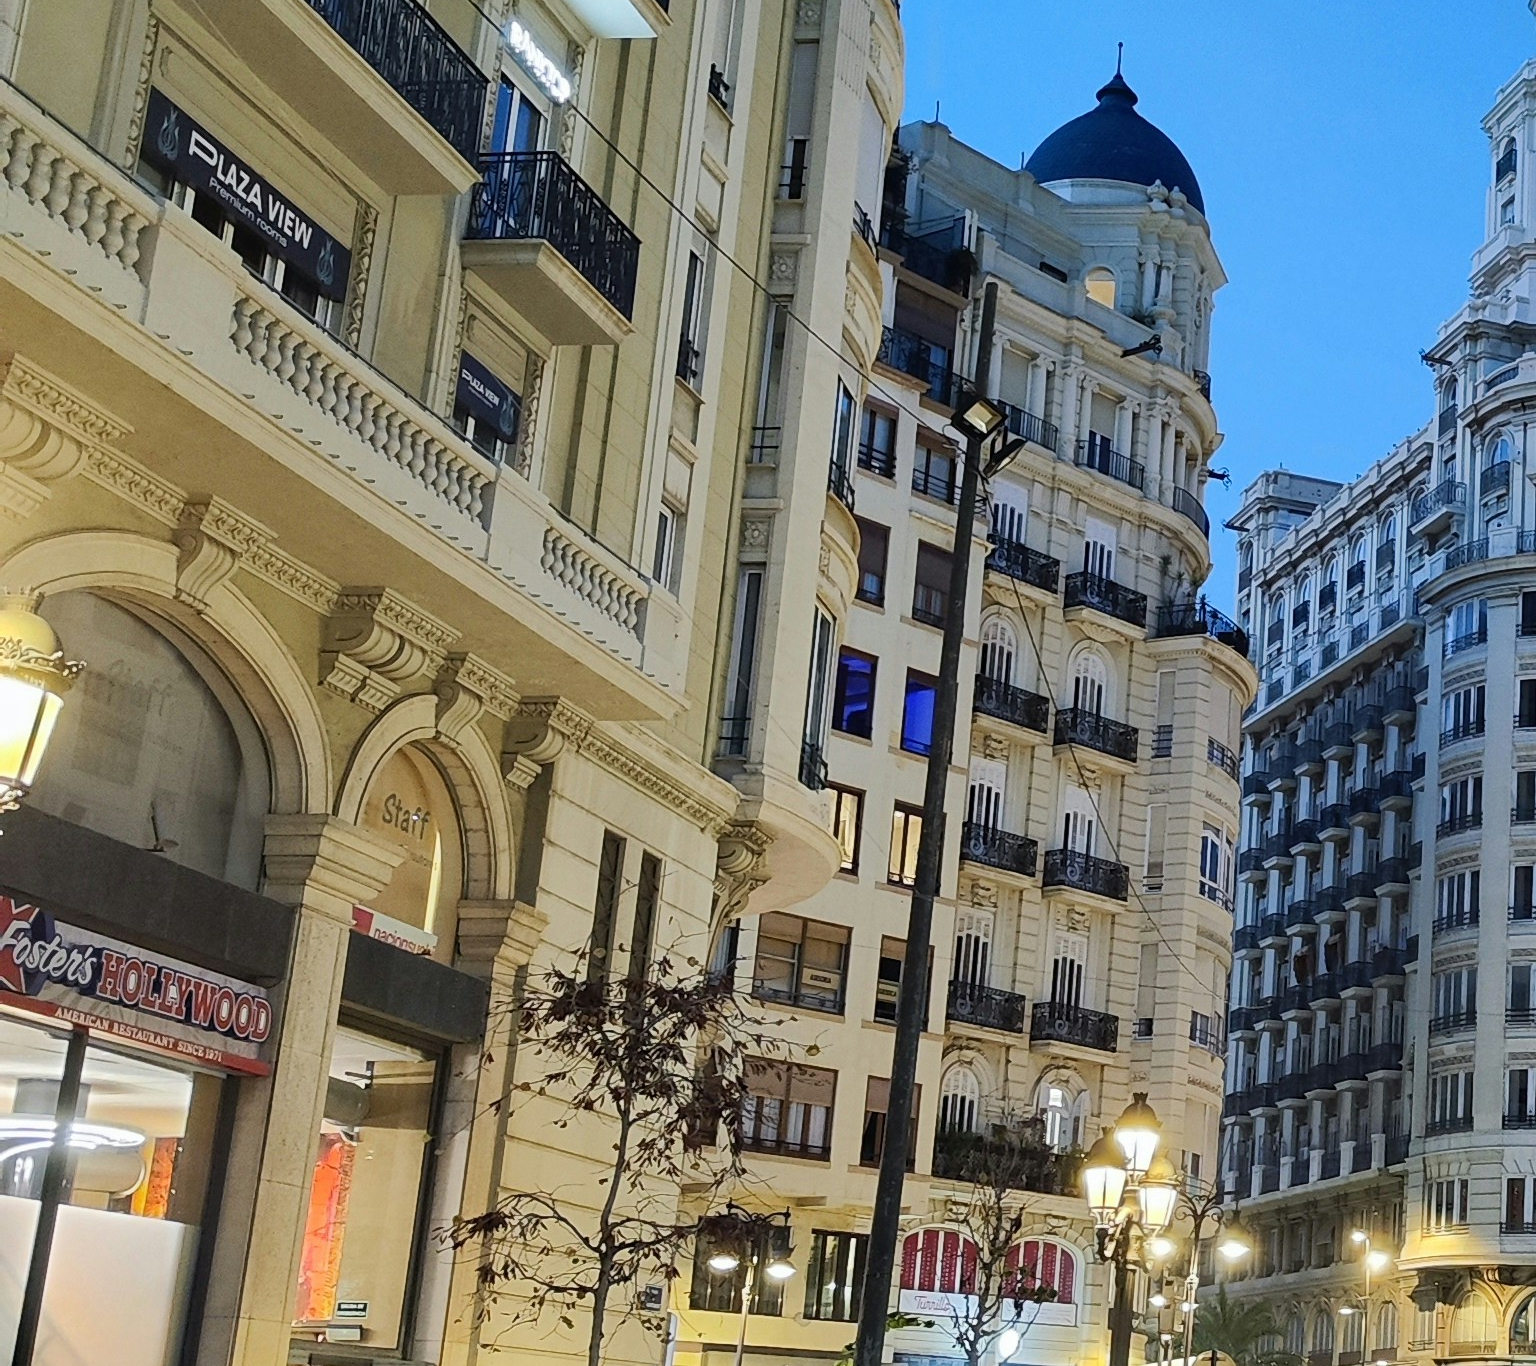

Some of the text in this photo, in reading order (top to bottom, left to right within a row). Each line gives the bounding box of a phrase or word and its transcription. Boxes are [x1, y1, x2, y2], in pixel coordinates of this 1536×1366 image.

[188, 129, 313, 250] PLAZA VIEW
[208, 176, 288, 248] Premium rooms
[381, 793, 431, 840] Staff
[0, 919, 273, 1043] Foster's HOLLYWOOD
[55, 1007, 110, 1032] AMERICAN
[112, 1021, 179, 1051] RESTAURANT
[176, 1039, 205, 1058] SINCE
